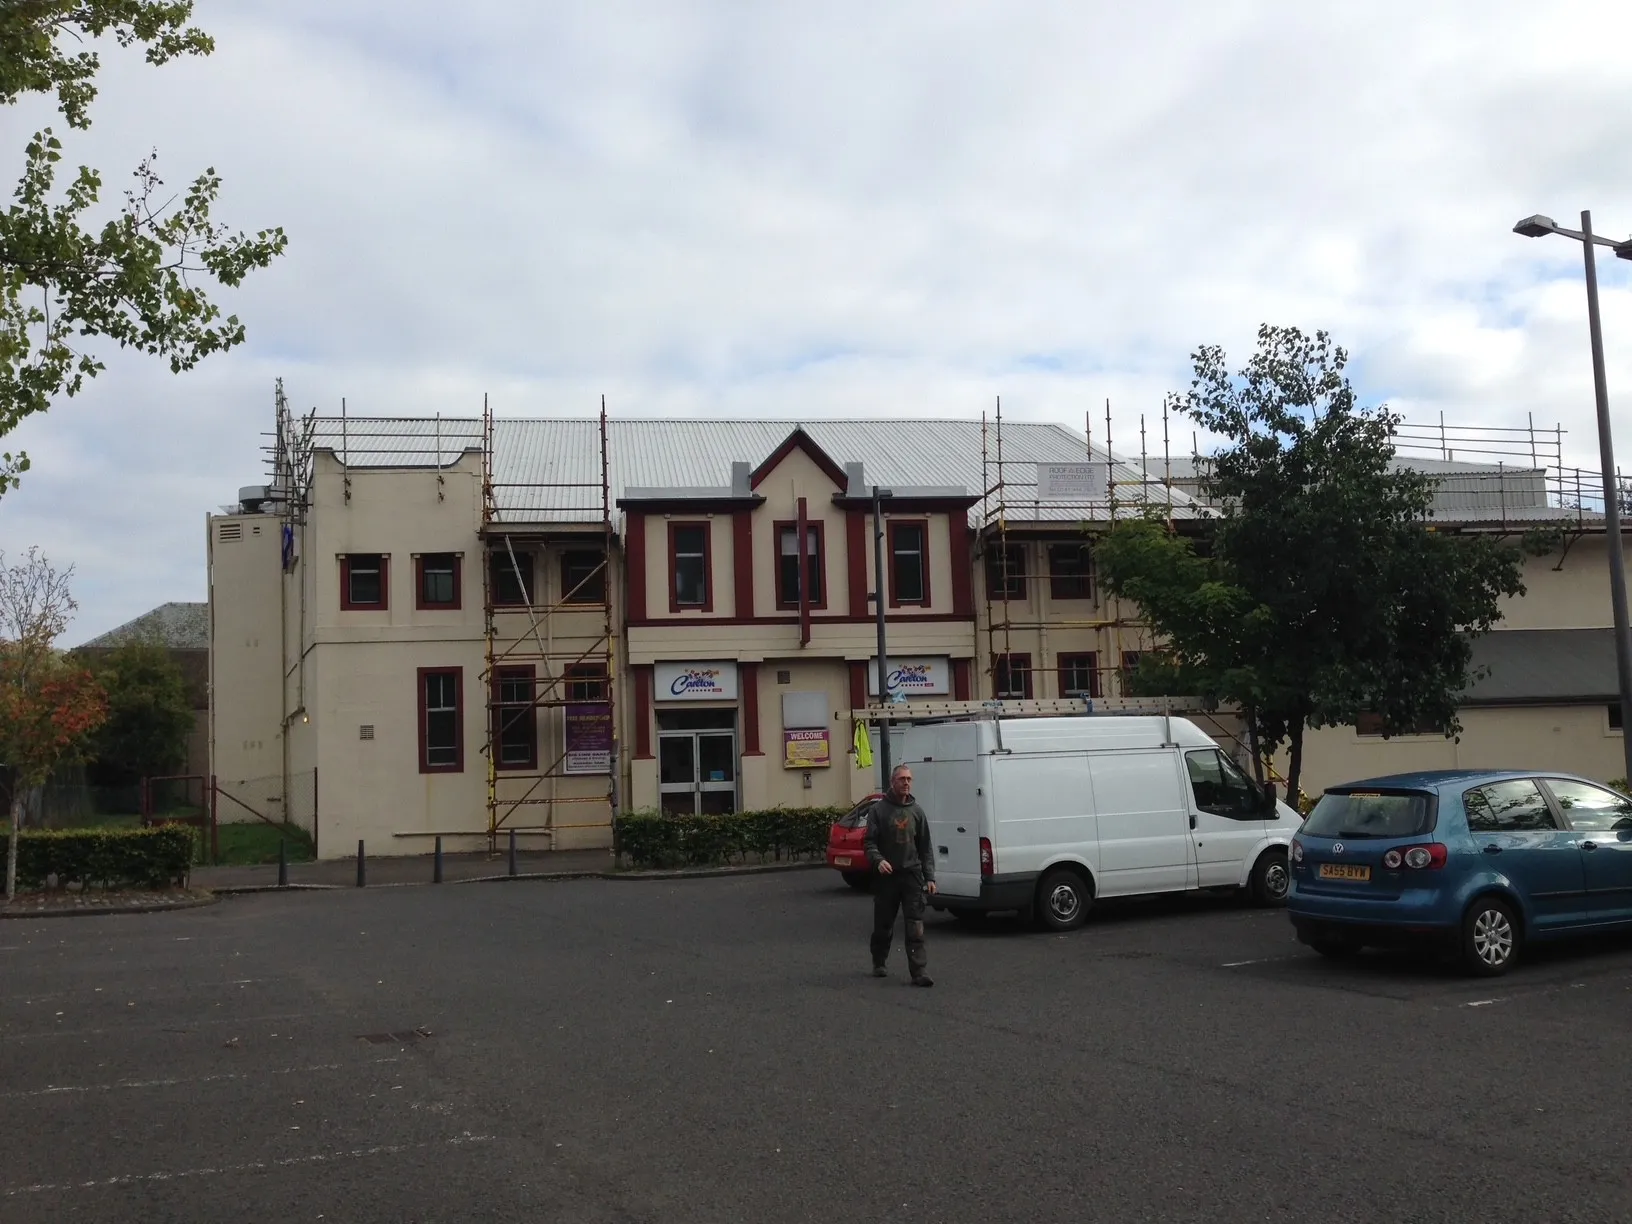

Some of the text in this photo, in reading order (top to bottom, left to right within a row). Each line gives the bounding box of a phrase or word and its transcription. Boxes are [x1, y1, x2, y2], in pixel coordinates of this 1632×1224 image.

[671, 675, 715, 695] Carlton
[887, 670, 928, 690] Carlton
[791, 732, 823, 740] WELCOME
[1323, 865, 1366, 878] SA55 BYW
